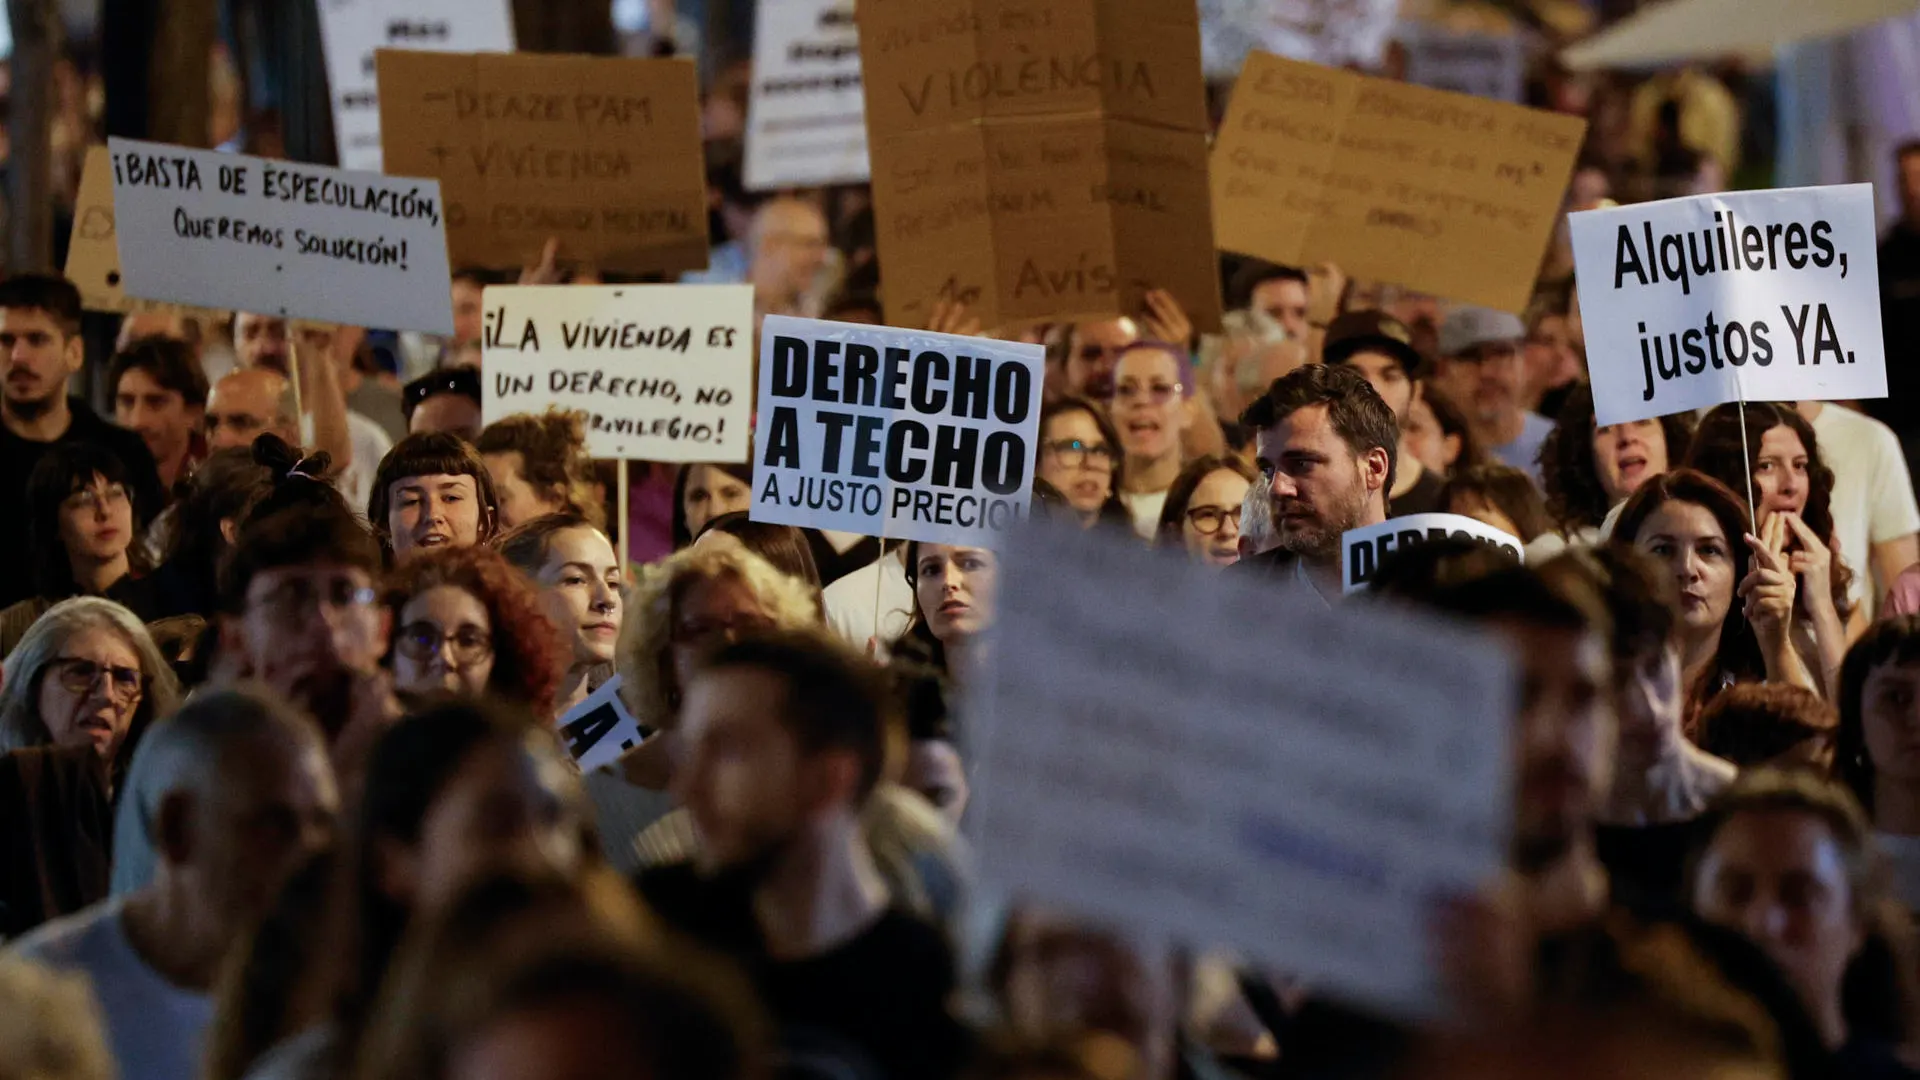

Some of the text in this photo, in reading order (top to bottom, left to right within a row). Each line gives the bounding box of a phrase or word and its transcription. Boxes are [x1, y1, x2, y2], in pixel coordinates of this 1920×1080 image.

[113, 154, 440, 227] ¡BASTA DE ESPECULACIÓN,
[173, 206, 409, 271] QUEREMOS SOLUCIÓN!
[1614, 210, 1848, 296] Alquileres,
[484, 306, 737, 354] ¡LA VIVIENDA ES
[1637, 303, 1856, 401] justos YA.
[495, 369, 733, 407] UN DERECHO, NO
[771, 335, 1031, 424] DERECHO
[764, 406, 1026, 495] A TECHO
[760, 472, 781, 505] A
[788, 476, 883, 516] JUSTO
